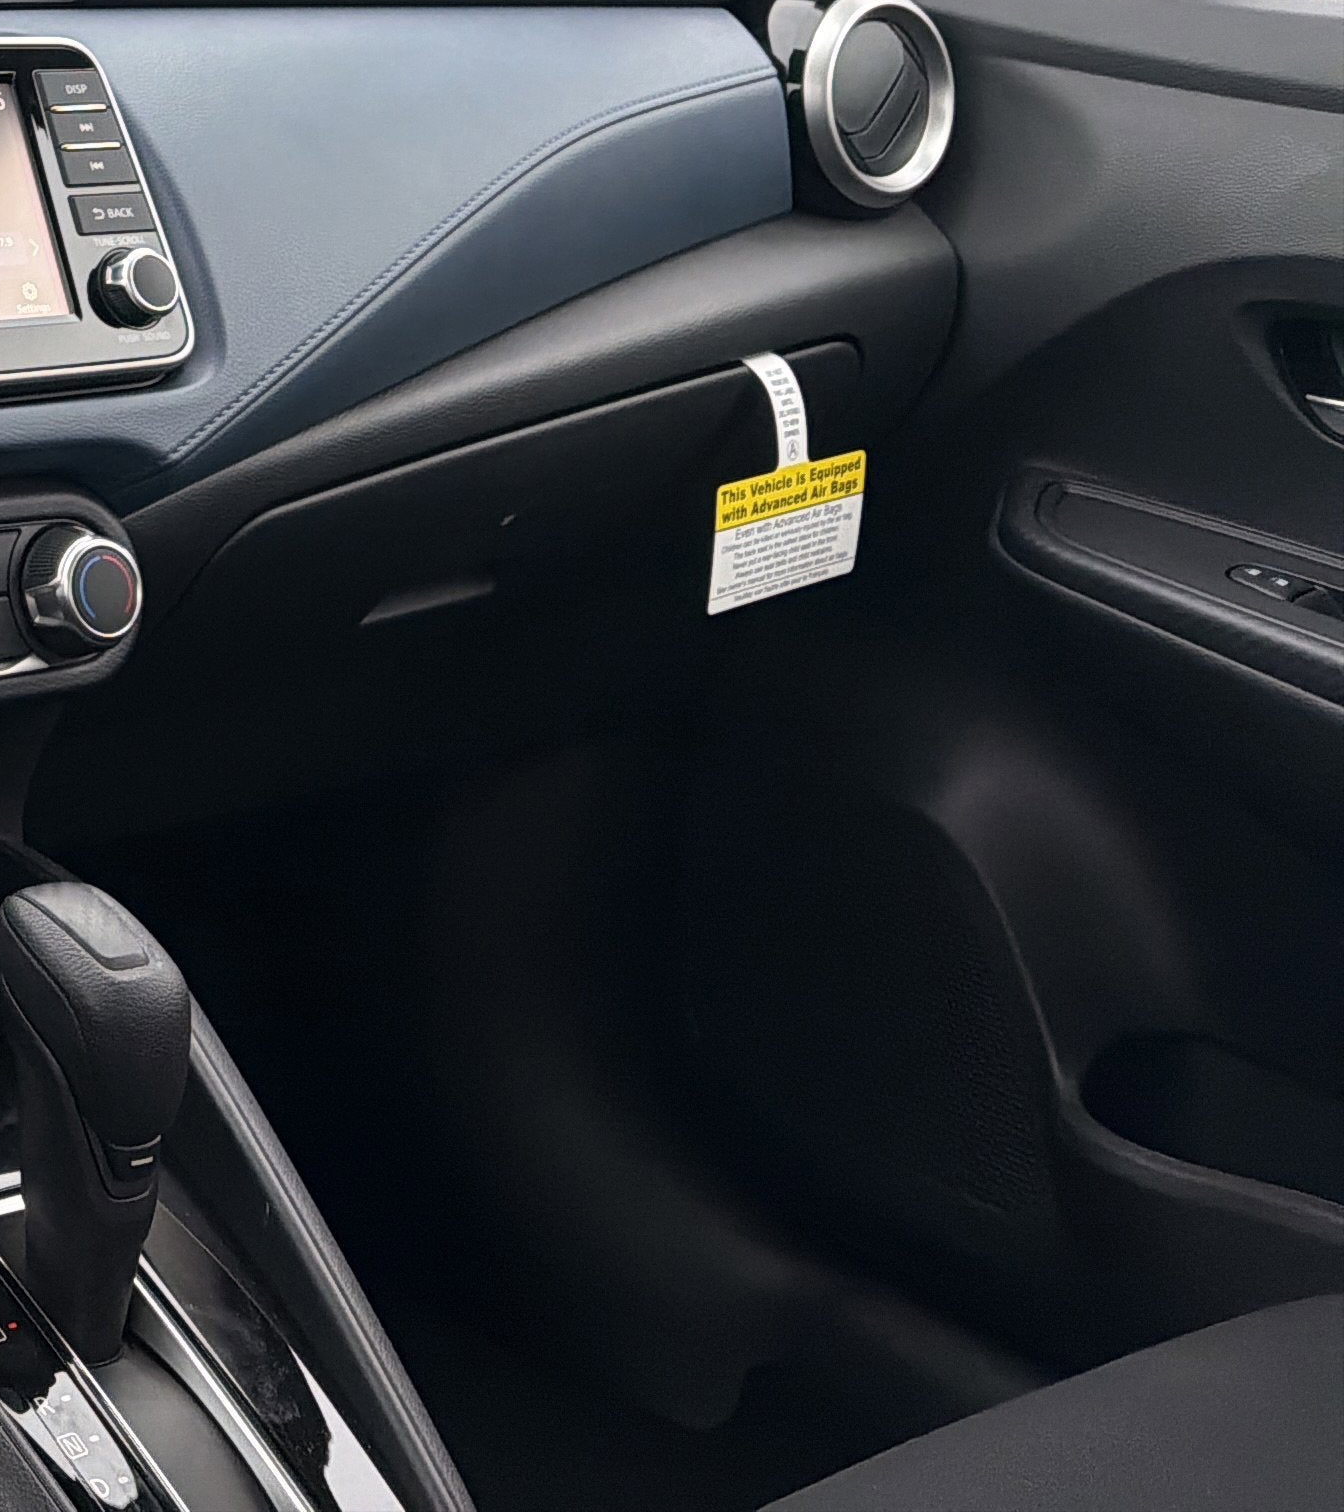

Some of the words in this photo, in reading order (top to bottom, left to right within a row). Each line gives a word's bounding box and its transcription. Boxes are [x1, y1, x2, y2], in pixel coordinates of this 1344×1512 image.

[65, 84, 87, 95] DISP
[108, 207, 135, 218] BACK
[720, 485, 747, 506] This
[749, 473, 793, 498] Vehicle
[808, 455, 861, 485] Equipped
[721, 503, 747, 524] with
[750, 487, 808, 517] Advanced
[810, 482, 827, 500] Air
[829, 473, 858, 497] Bags
[35, 1396, 55, 1416] R
[64, 1437, 81, 1454] N
[90, 1478, 109, 1497] D
